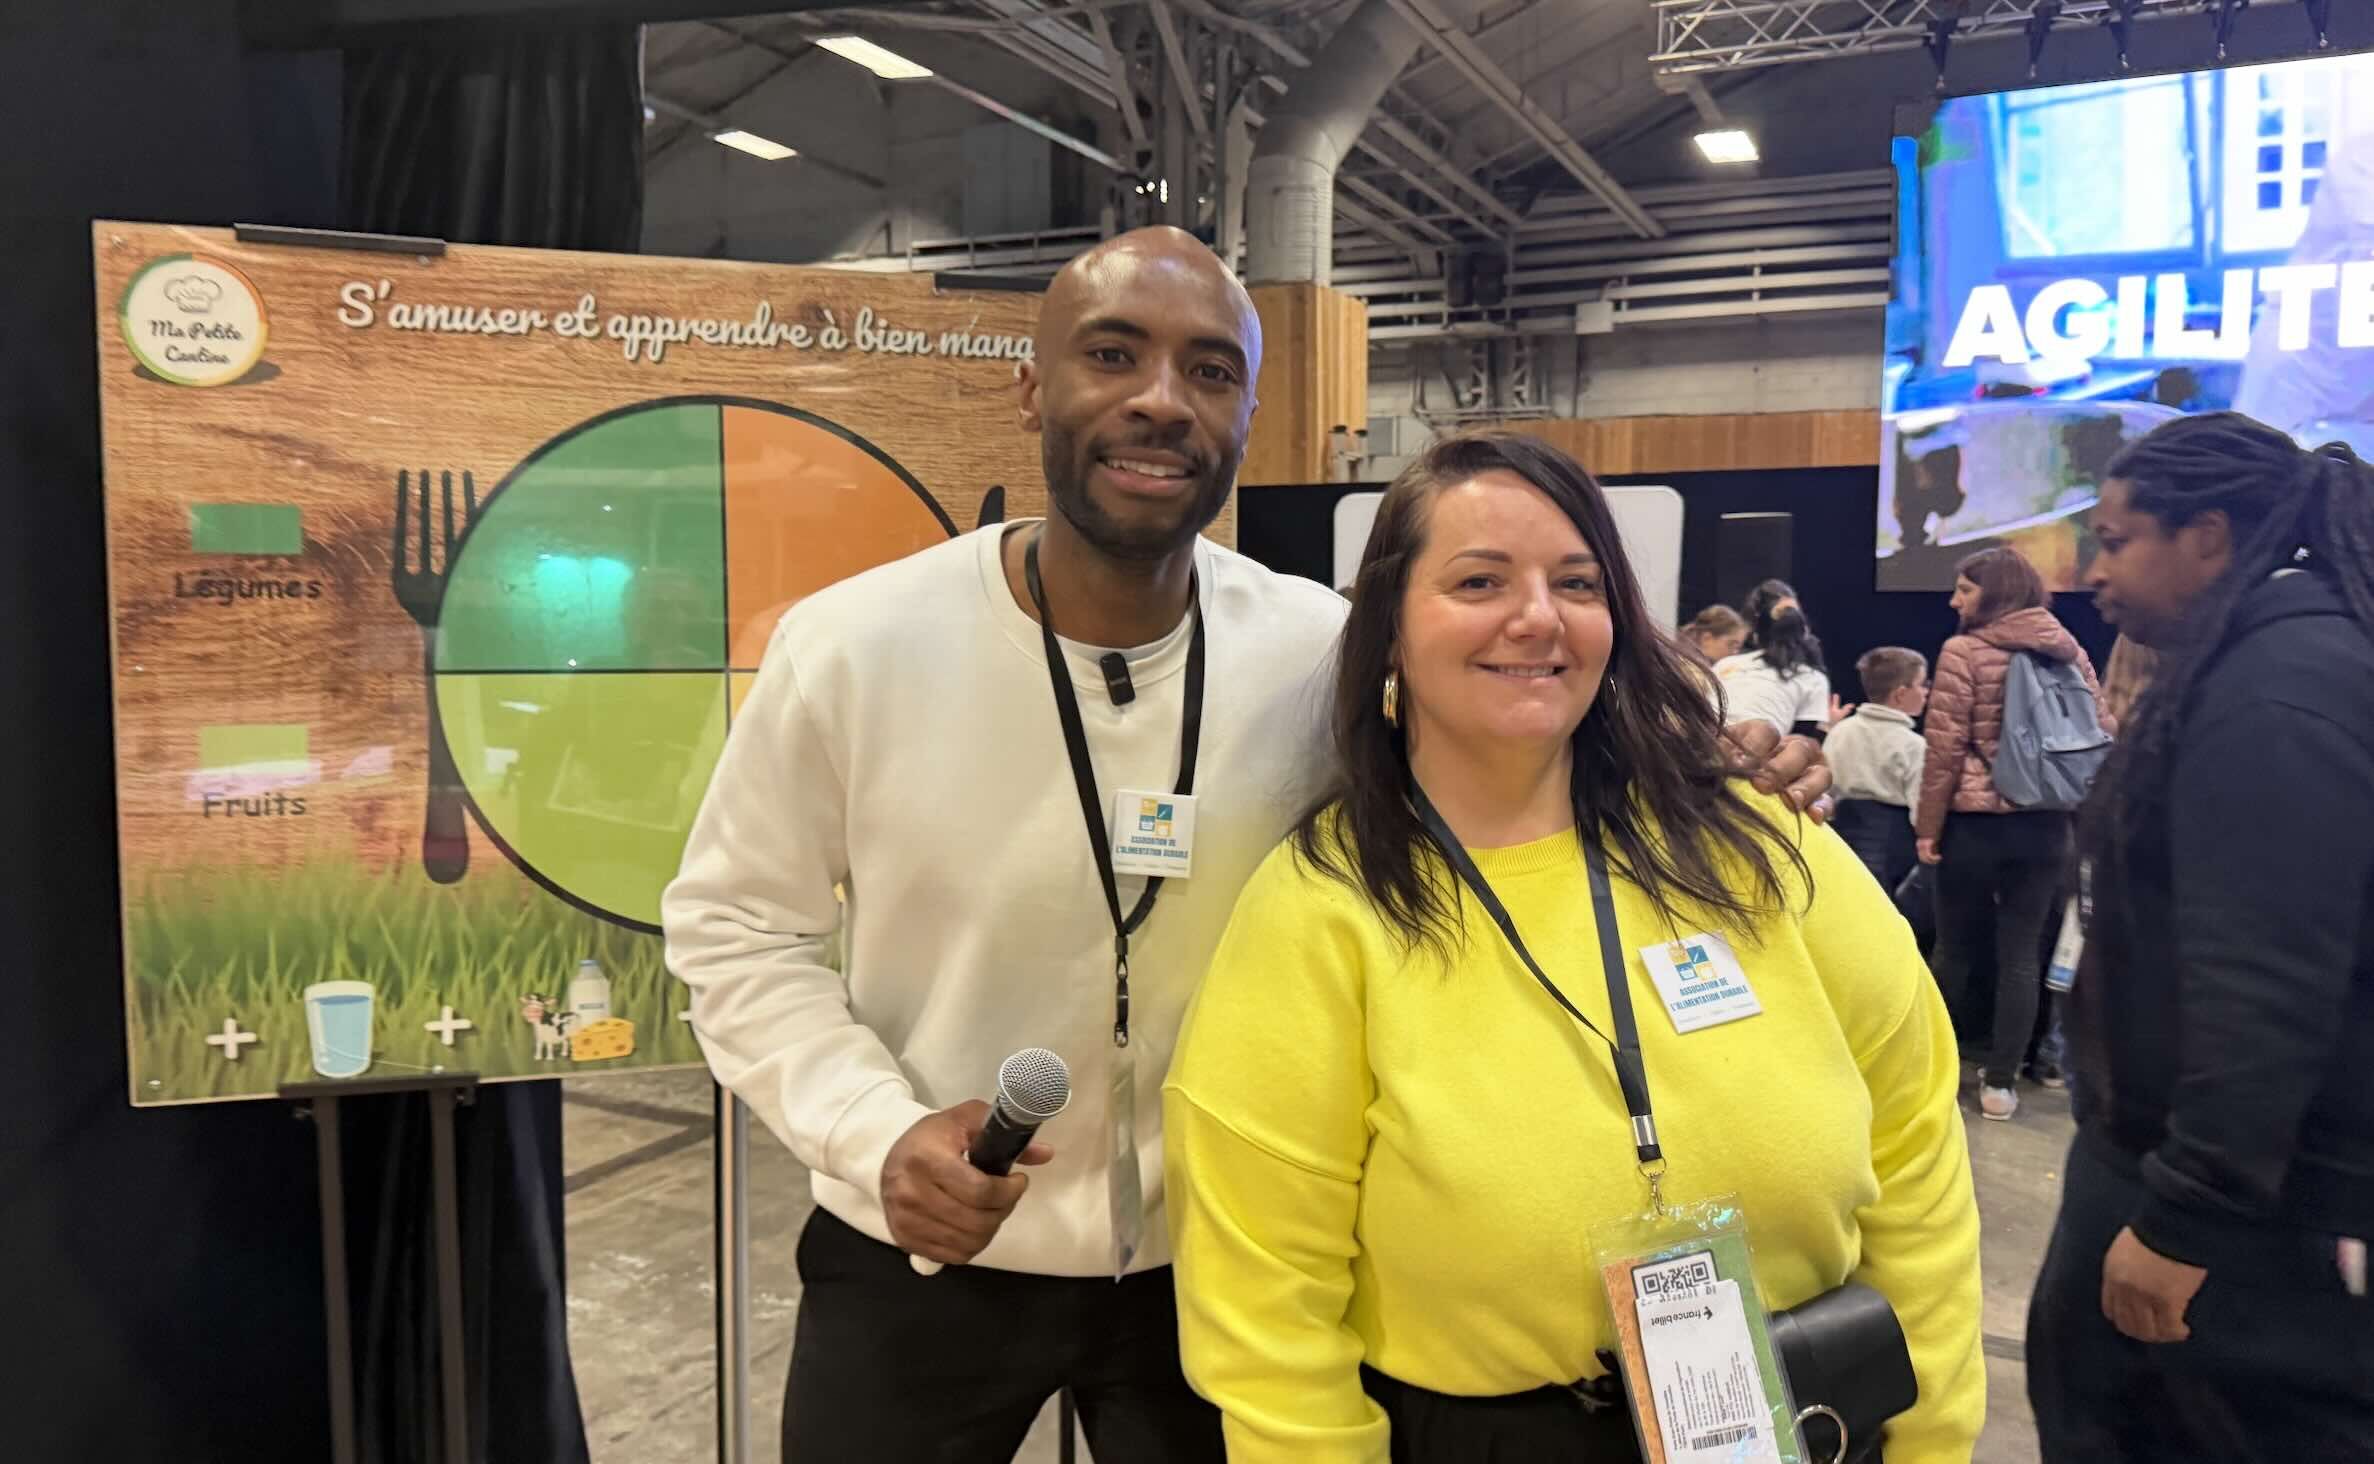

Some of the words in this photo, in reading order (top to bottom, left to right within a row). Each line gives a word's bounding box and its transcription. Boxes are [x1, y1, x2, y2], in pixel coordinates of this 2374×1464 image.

[337, 279, 549, 335] S'amuser
[554, 293, 600, 338] et
[607, 301, 813, 361] apprendre
[820, 309, 848, 350] à
[855, 306, 933, 354] bien
[151, 320, 184, 338] Ma
[188, 321, 243, 341] Petite
[165, 345, 231, 364] Cantine
[203, 791, 307, 818] Fruits
[1680, 980, 1719, 996] ASSOCIATION
[1719, 977, 1728, 986] DE
[1720, 985, 1748, 999] DURABLE
